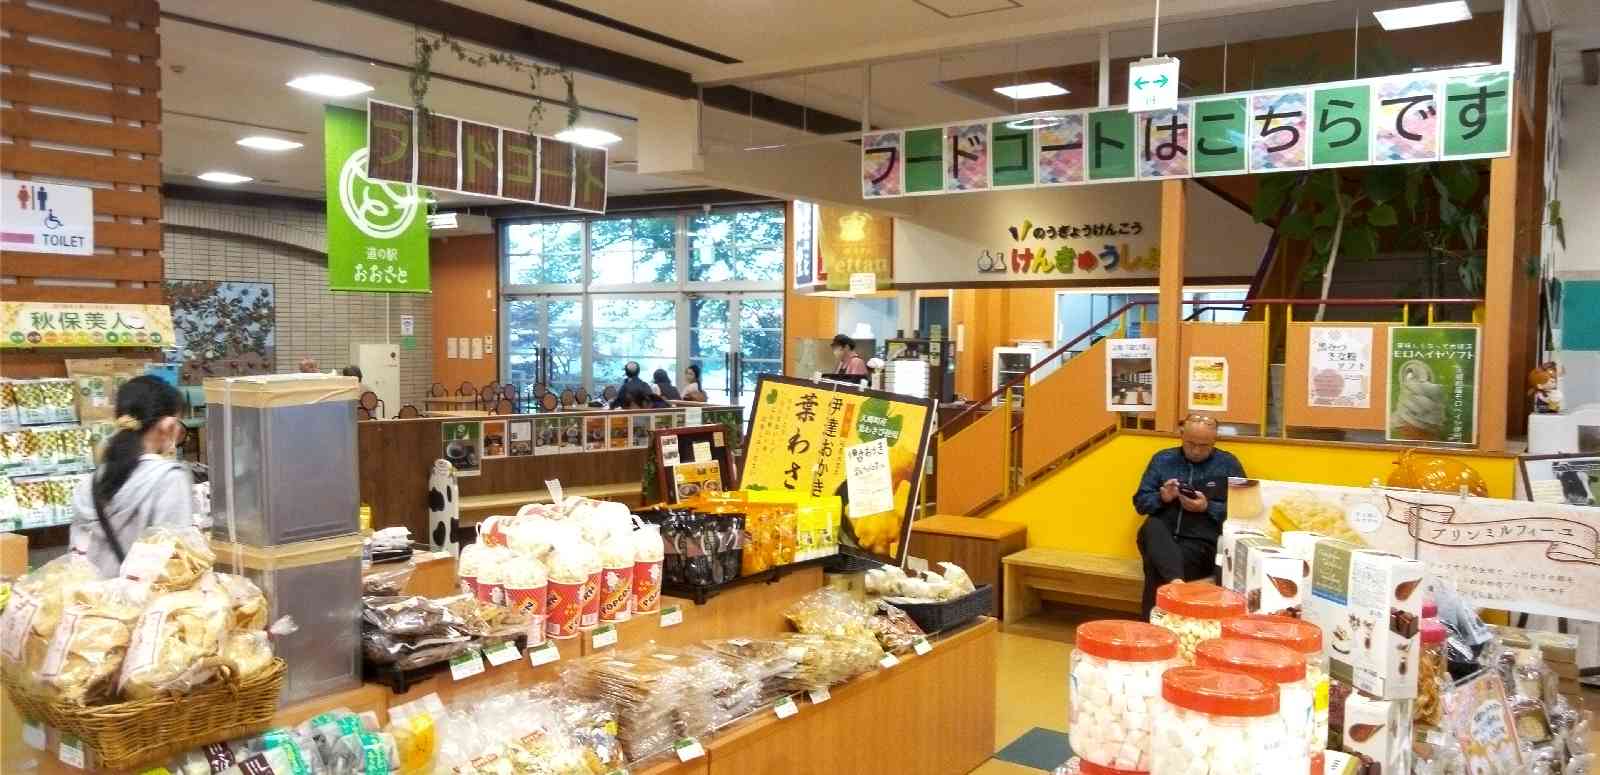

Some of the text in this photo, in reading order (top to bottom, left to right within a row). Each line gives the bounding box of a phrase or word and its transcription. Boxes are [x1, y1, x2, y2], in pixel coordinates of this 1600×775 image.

[865, 86, 1505, 185] フードコートはこちらです
[373, 112, 603, 207] フードコート
[42, 233, 85, 248] TOILET
[1033, 222, 1143, 241] のうぎょうけんこう
[367, 247, 398, 261] 道の駅
[354, 263, 408, 283] おおさと
[31, 310, 131, 330] 秋保美人
[1393, 350, 1473, 360] モロヘイヤソフト
